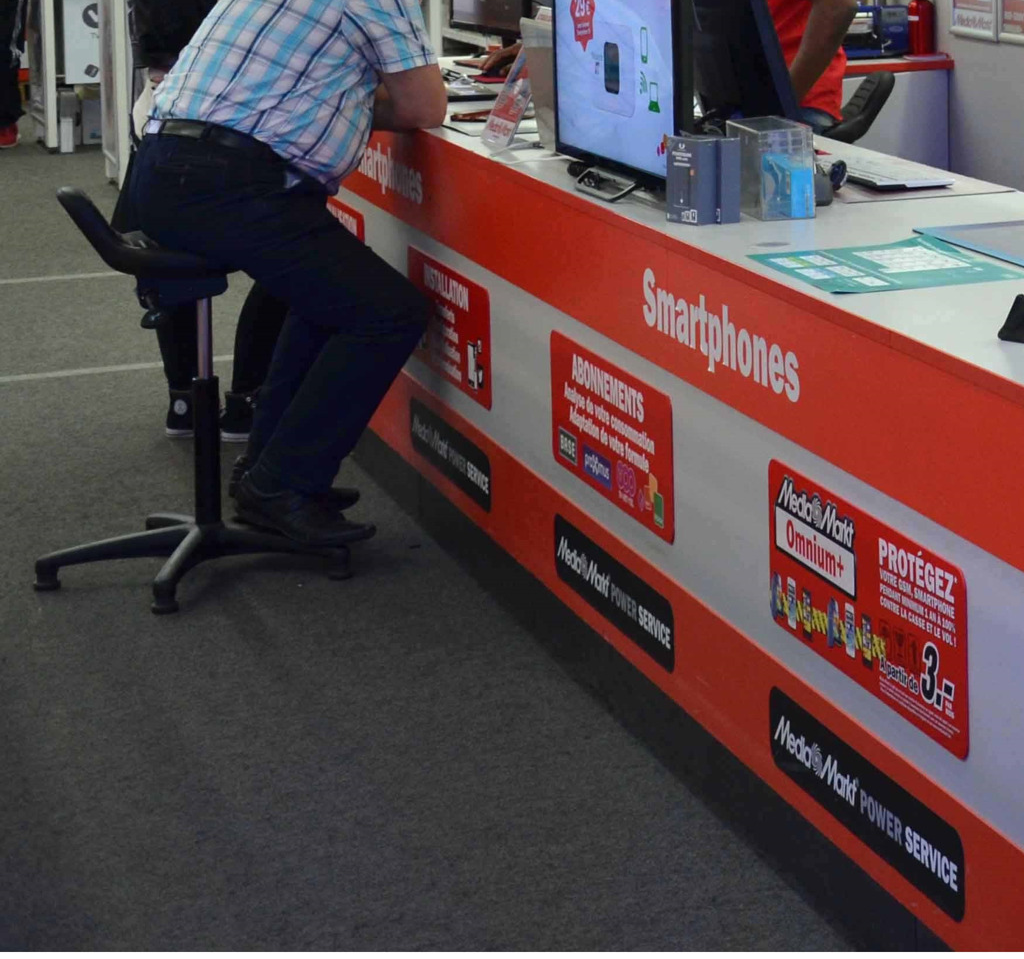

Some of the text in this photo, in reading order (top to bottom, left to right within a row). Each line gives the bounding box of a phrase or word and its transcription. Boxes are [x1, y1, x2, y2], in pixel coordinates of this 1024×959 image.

[358, 142, 423, 205] artphones
[423, 262, 469, 312] INSTALLATION
[643, 268, 800, 403] Smartphones
[572, 354, 644, 423] ABONNEMENTS
[564, 382, 655, 455] Analyse de votre consommation
[600, 427, 608, 445] de
[609, 435, 624, 457] votre
[560, 435, 575, 458] BASE
[466, 462, 489, 494] SERVICE
[778, 479, 854, 549] Media Markt
[786, 520, 844, 578] Omnium+
[611, 583, 637, 621] POWER
[638, 605, 671, 649] SERVICE
[879, 567, 955, 619] VOTRE GSM, SMARTPHONE
[880, 583, 901, 603] PENDANT
[901, 595, 924, 615] MINIMUM
[928, 608, 937, 621] AN
[942, 616, 956, 634] 100%
[880, 596, 953, 646] CONTRE LA CASSE ET LE VOL
[885, 660, 907, 687] partir
[908, 674, 919, 695] de
[774, 715, 958, 892] Media Markt POWER SERVICE
